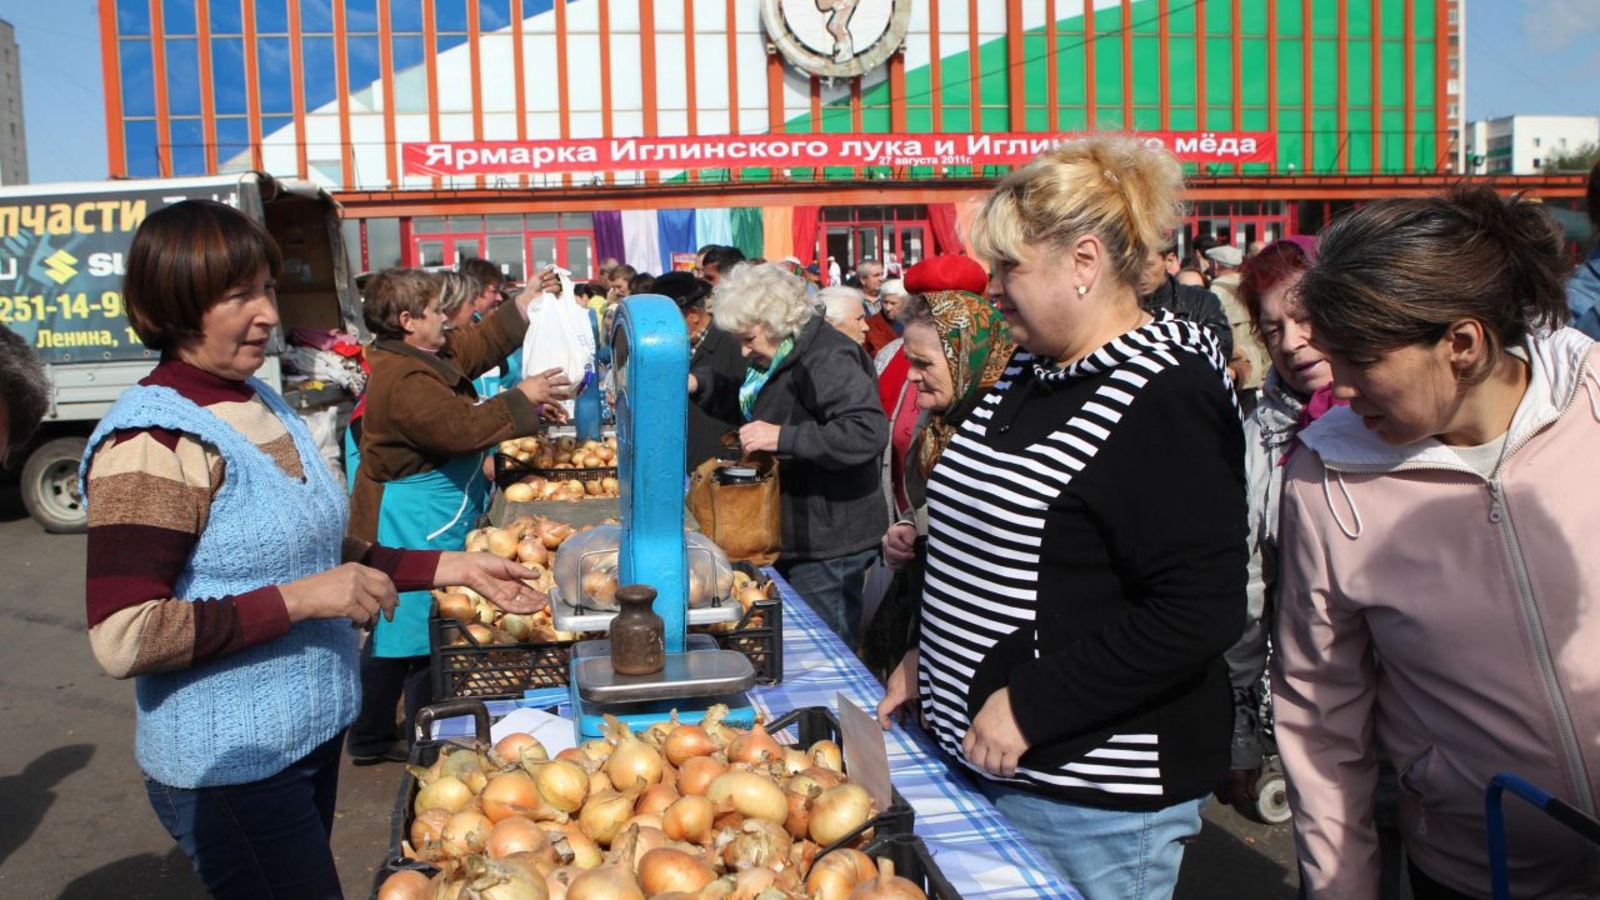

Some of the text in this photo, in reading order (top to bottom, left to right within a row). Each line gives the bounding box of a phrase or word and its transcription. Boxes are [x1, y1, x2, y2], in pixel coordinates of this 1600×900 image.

[425, 144, 597, 170] Ярмарка
[610, 139, 829, 161] Иглинского
[839, 139, 922, 162] лука
[934, 140, 954, 156] и
[1175, 132, 1257, 156] мёда
[879, 155, 892, 166] 27
[895, 156, 939, 167] августа
[0, 291, 128, 323] 251-14-9
[37, 329, 118, 348] Ленина,
